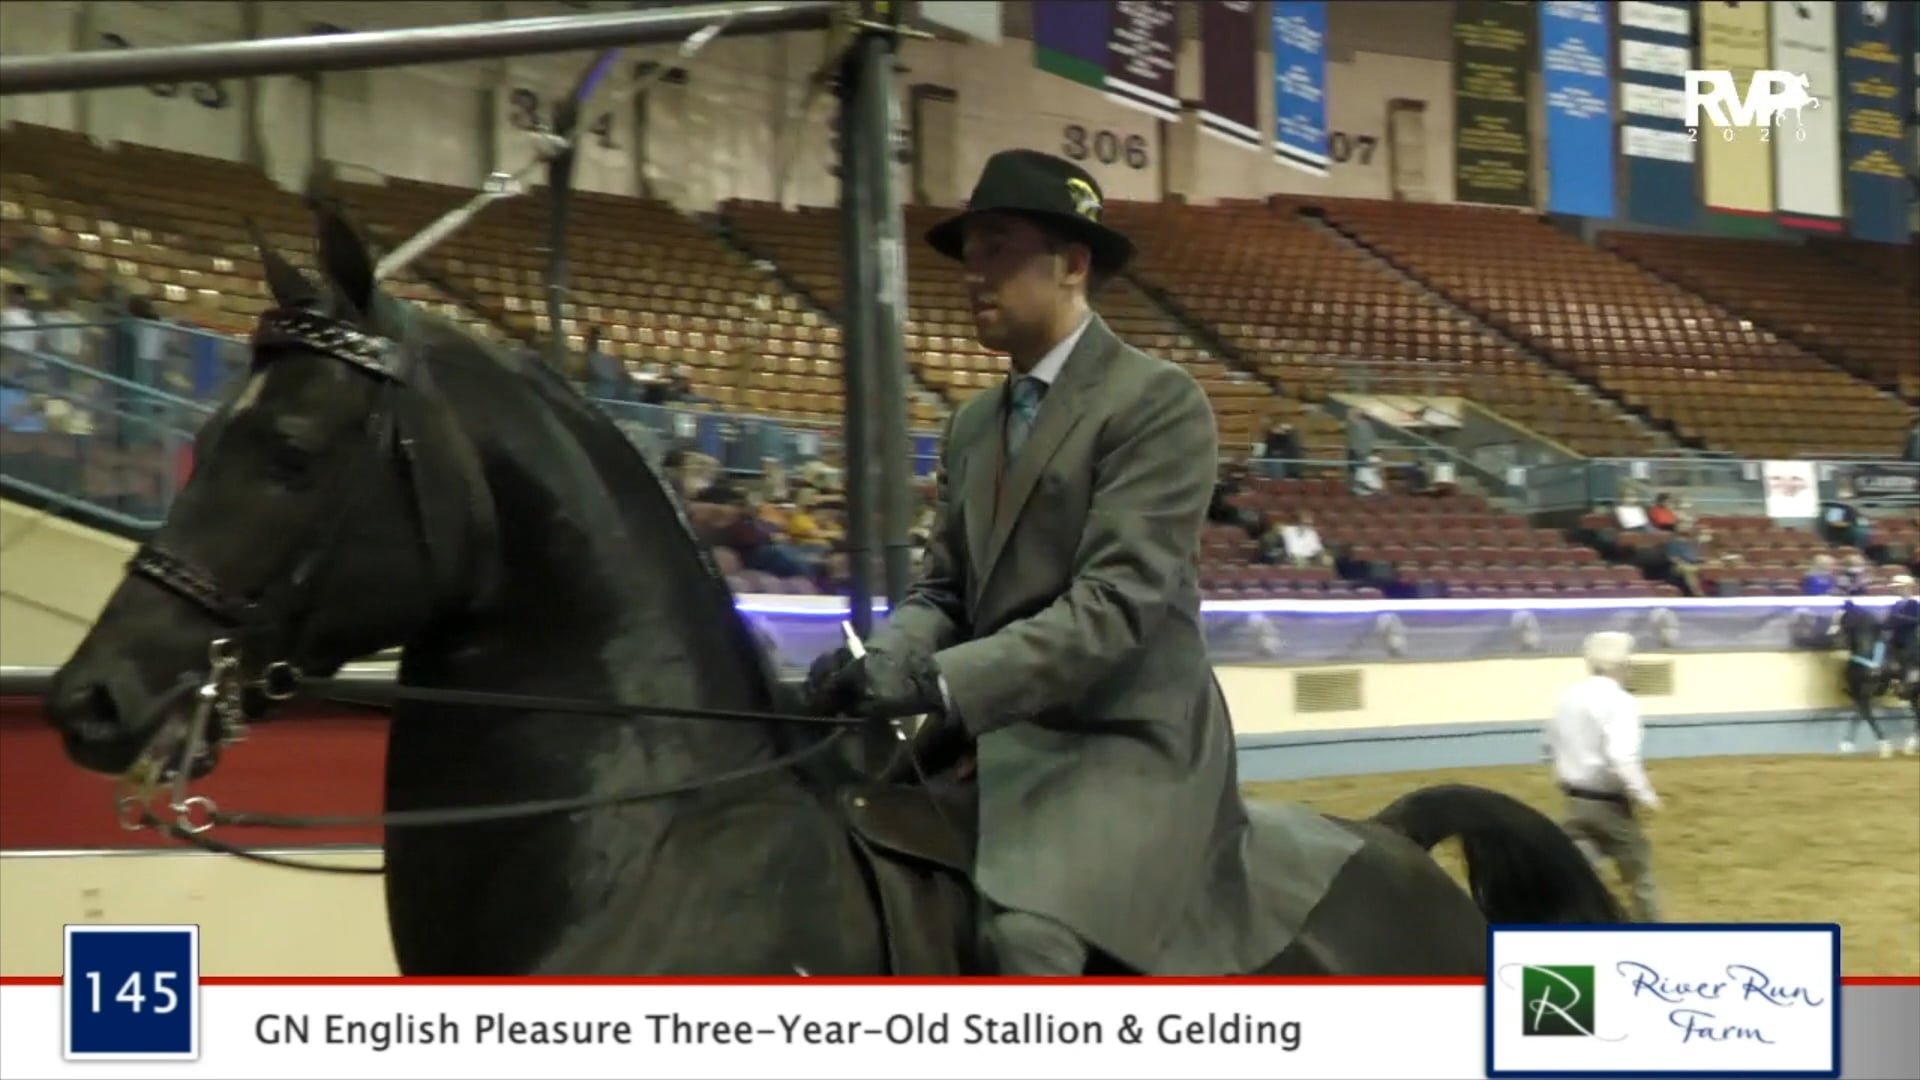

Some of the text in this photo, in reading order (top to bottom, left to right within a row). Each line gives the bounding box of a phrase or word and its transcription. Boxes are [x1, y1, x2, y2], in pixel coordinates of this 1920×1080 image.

[510, 87, 621, 150] 34
[1062, 124, 1148, 169] 306
[1328, 131, 1379, 166] 07
